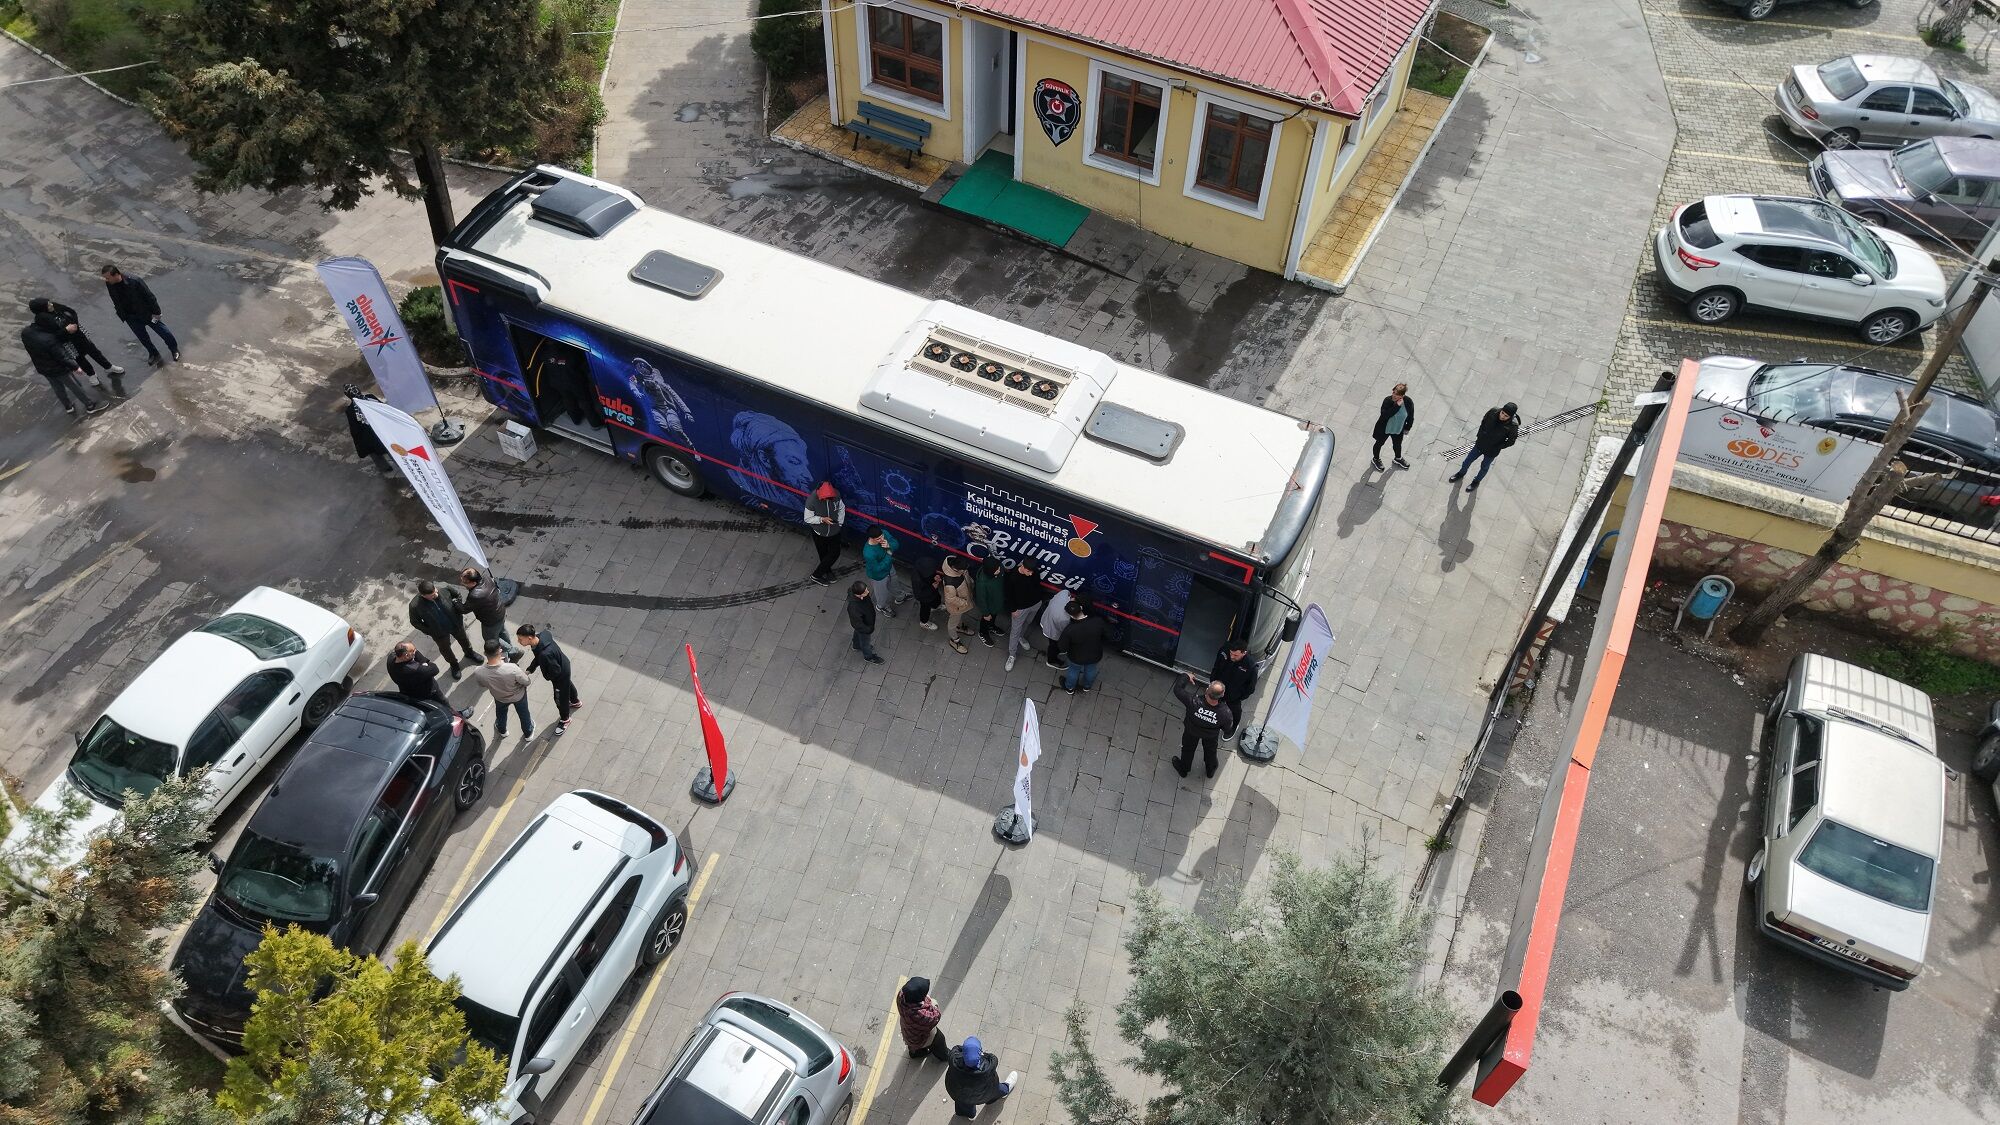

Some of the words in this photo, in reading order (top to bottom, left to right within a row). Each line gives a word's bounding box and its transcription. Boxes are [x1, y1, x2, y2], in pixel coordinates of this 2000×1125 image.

[598, 395, 633, 416] sula
[1730, 441, 1804, 468] SODES
[965, 502, 1018, 528] Büyükşehir
[1019, 520, 1068, 548] Belediyesi
[967, 491, 1069, 538] Kahramanmaraş
[991, 529, 1061, 565] Bilim
